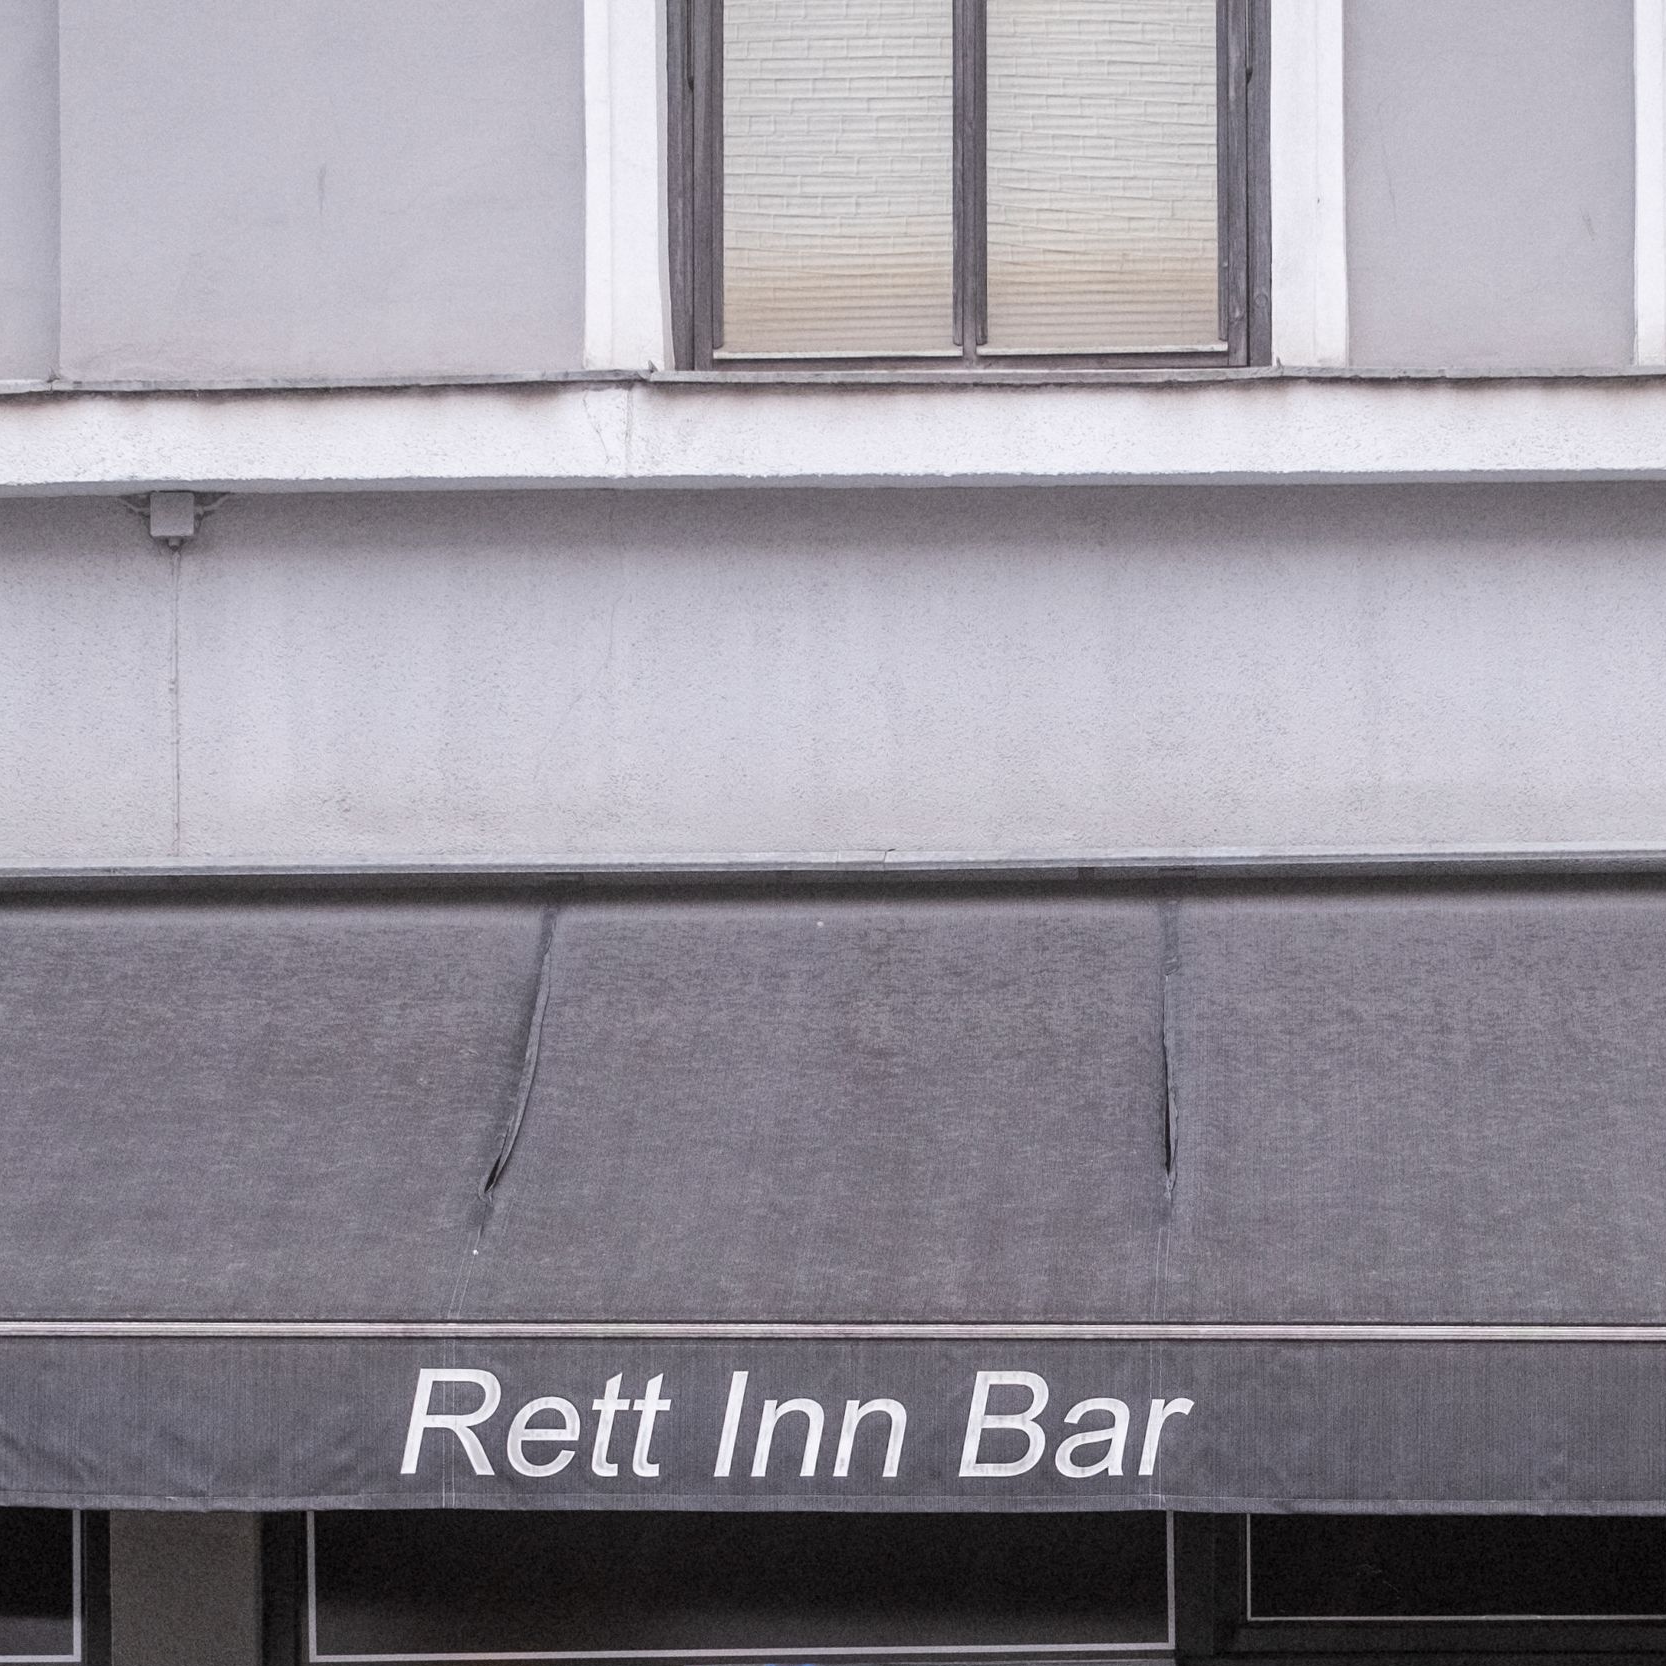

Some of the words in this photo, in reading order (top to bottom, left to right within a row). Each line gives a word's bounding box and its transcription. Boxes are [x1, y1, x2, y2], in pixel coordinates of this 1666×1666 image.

[401, 1368, 671, 1477] Rett
[714, 1371, 907, 1477] Inn
[959, 1371, 1194, 1478] Bar
